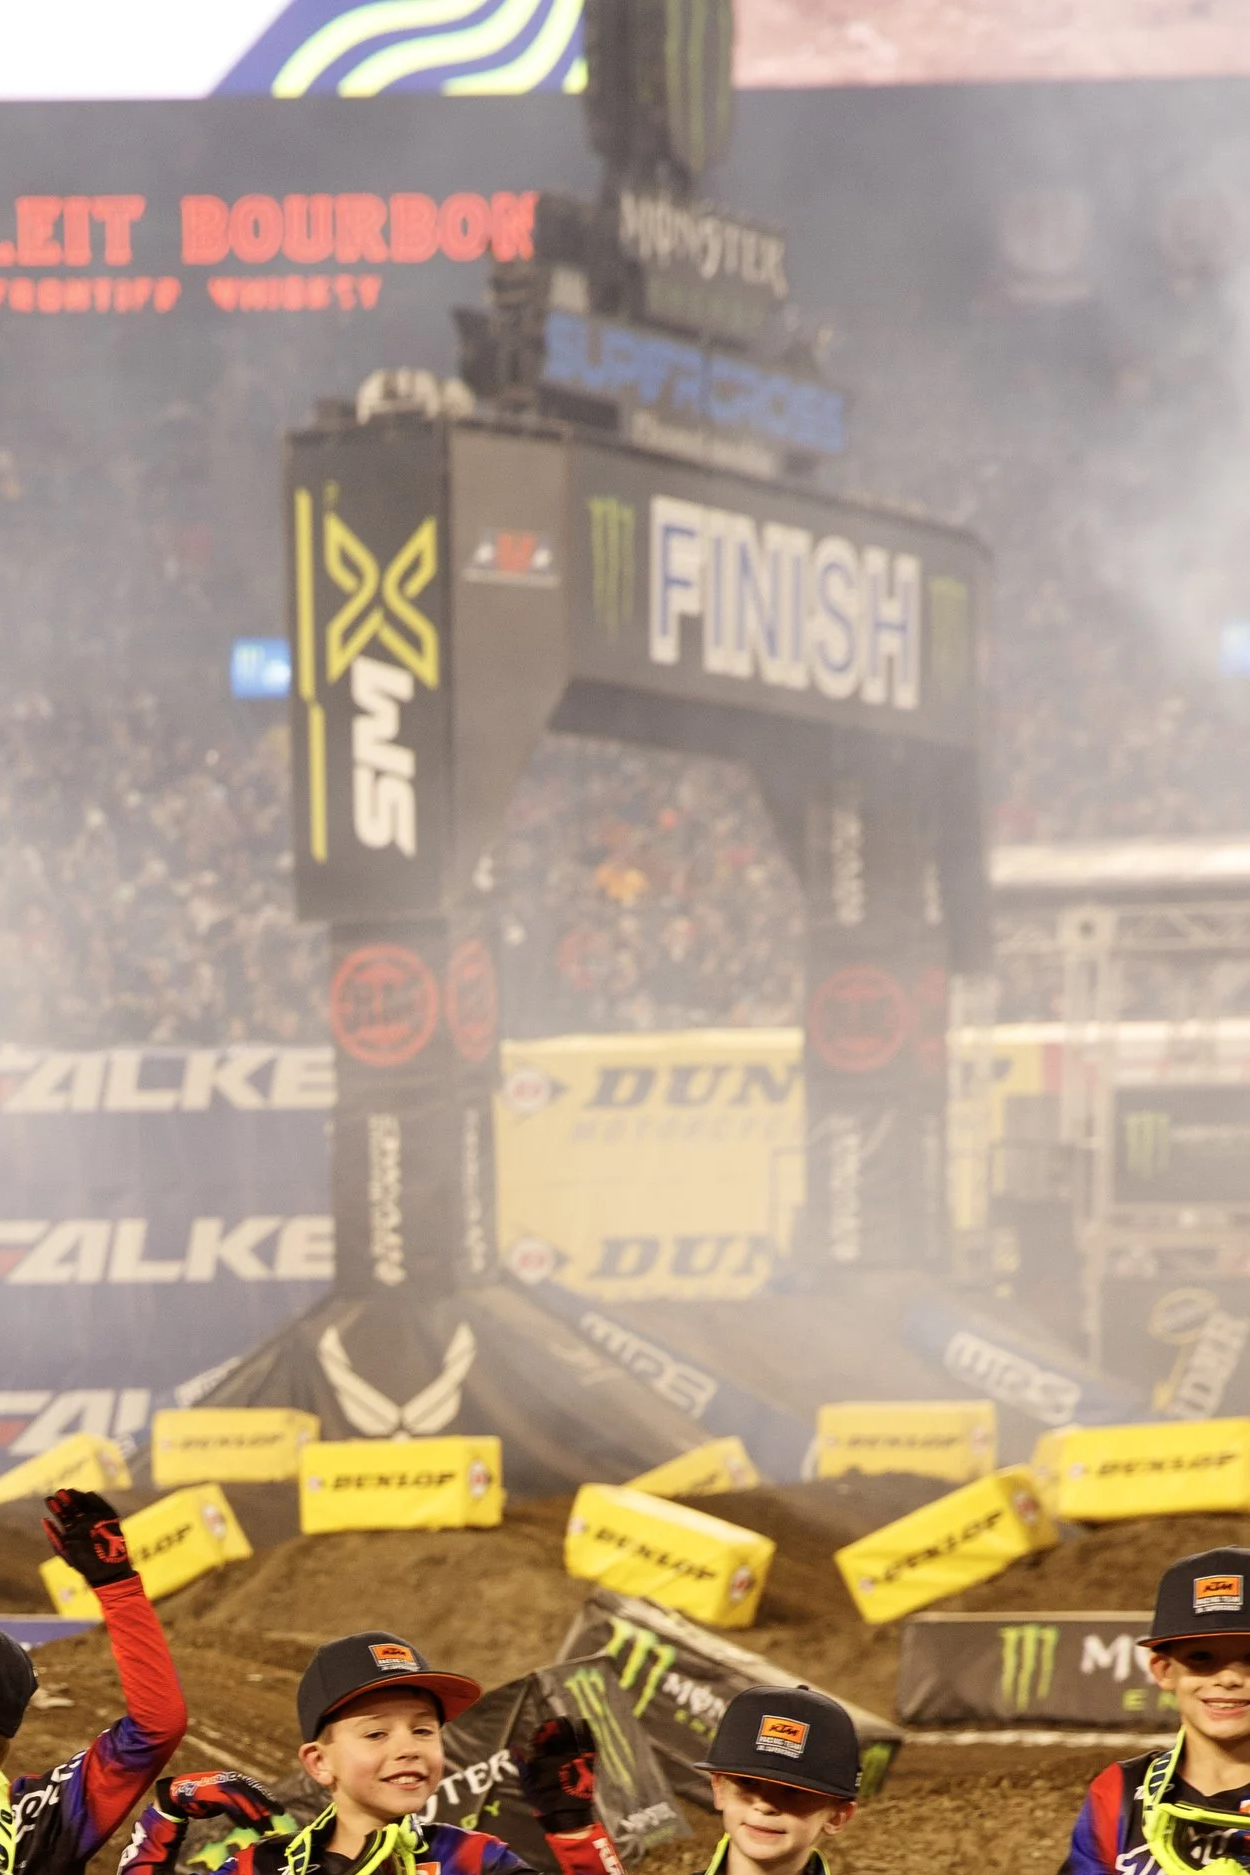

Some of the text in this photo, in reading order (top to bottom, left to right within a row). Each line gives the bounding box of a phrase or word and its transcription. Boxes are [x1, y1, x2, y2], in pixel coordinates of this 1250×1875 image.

[180, 191, 540, 265] BOURBON
[649, 494, 922, 711] FINISH
[332, 1470, 458, 1493] DUNLOP
[1096, 1451, 1241, 1479] DUNLOP
[593, 1525, 719, 1585] DUNLOP
[882, 1510, 1003, 1585] DUNLOP
[1203, 1581, 1233, 1593] KTM
[768, 1722, 799, 1737] KTM
